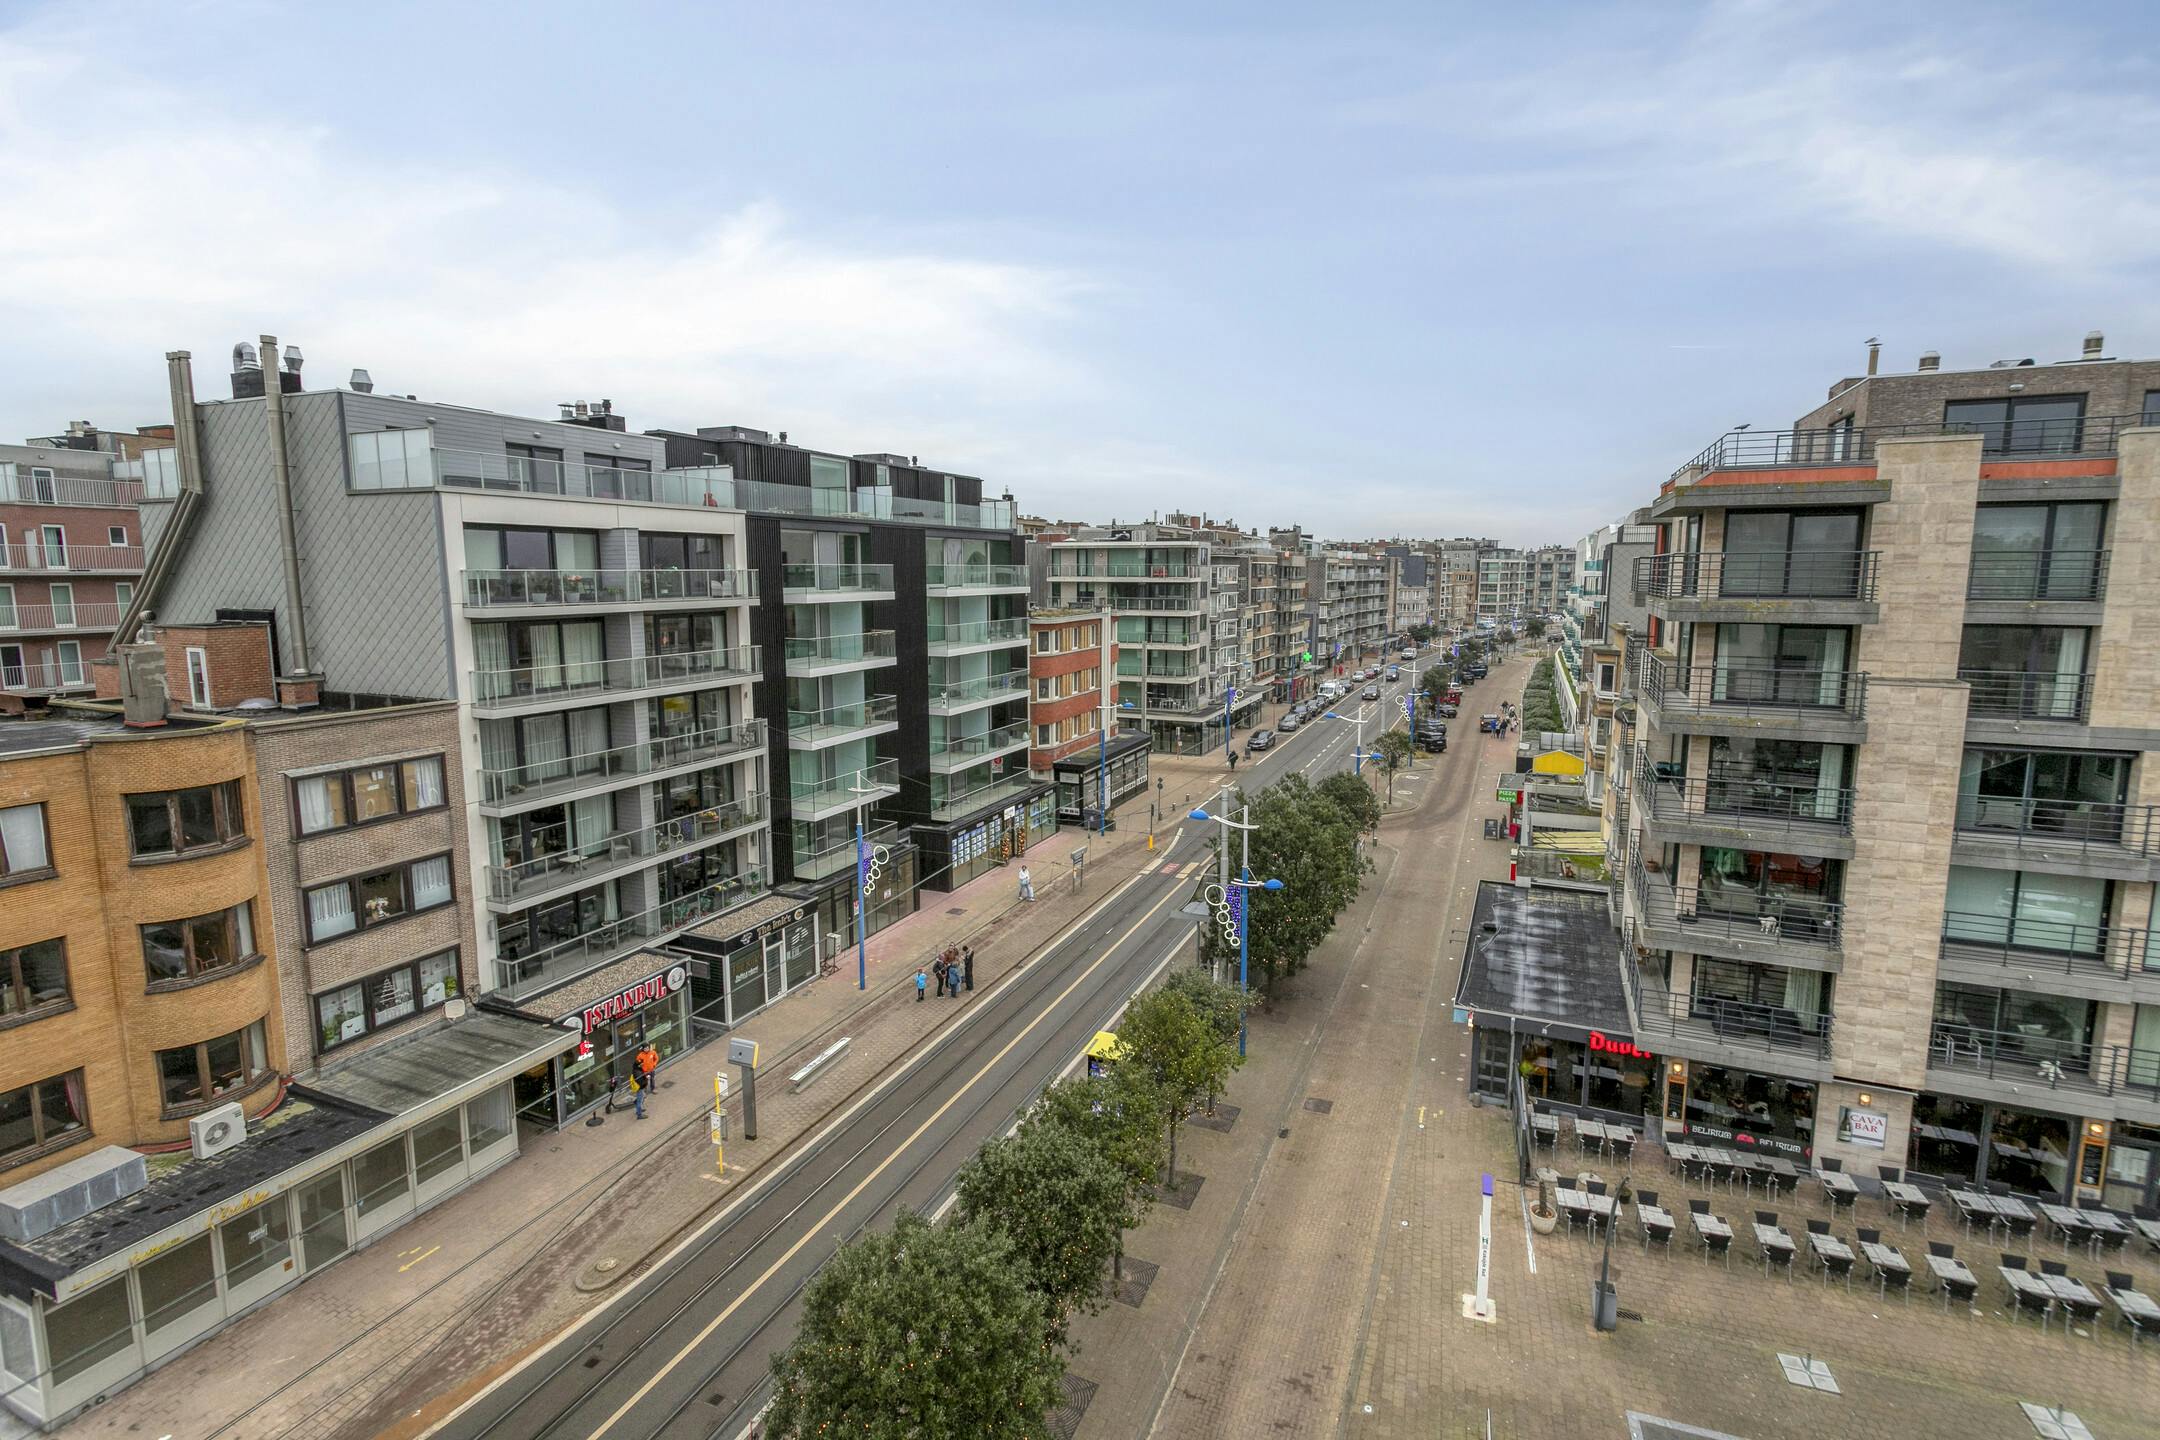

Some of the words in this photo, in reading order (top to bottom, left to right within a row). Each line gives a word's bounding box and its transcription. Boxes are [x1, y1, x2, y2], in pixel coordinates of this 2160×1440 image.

[583, 975, 667, 1035] ISTANBUL
[1850, 1114, 1883, 1127] CAVA
[1855, 1122, 1878, 1133] BAR
